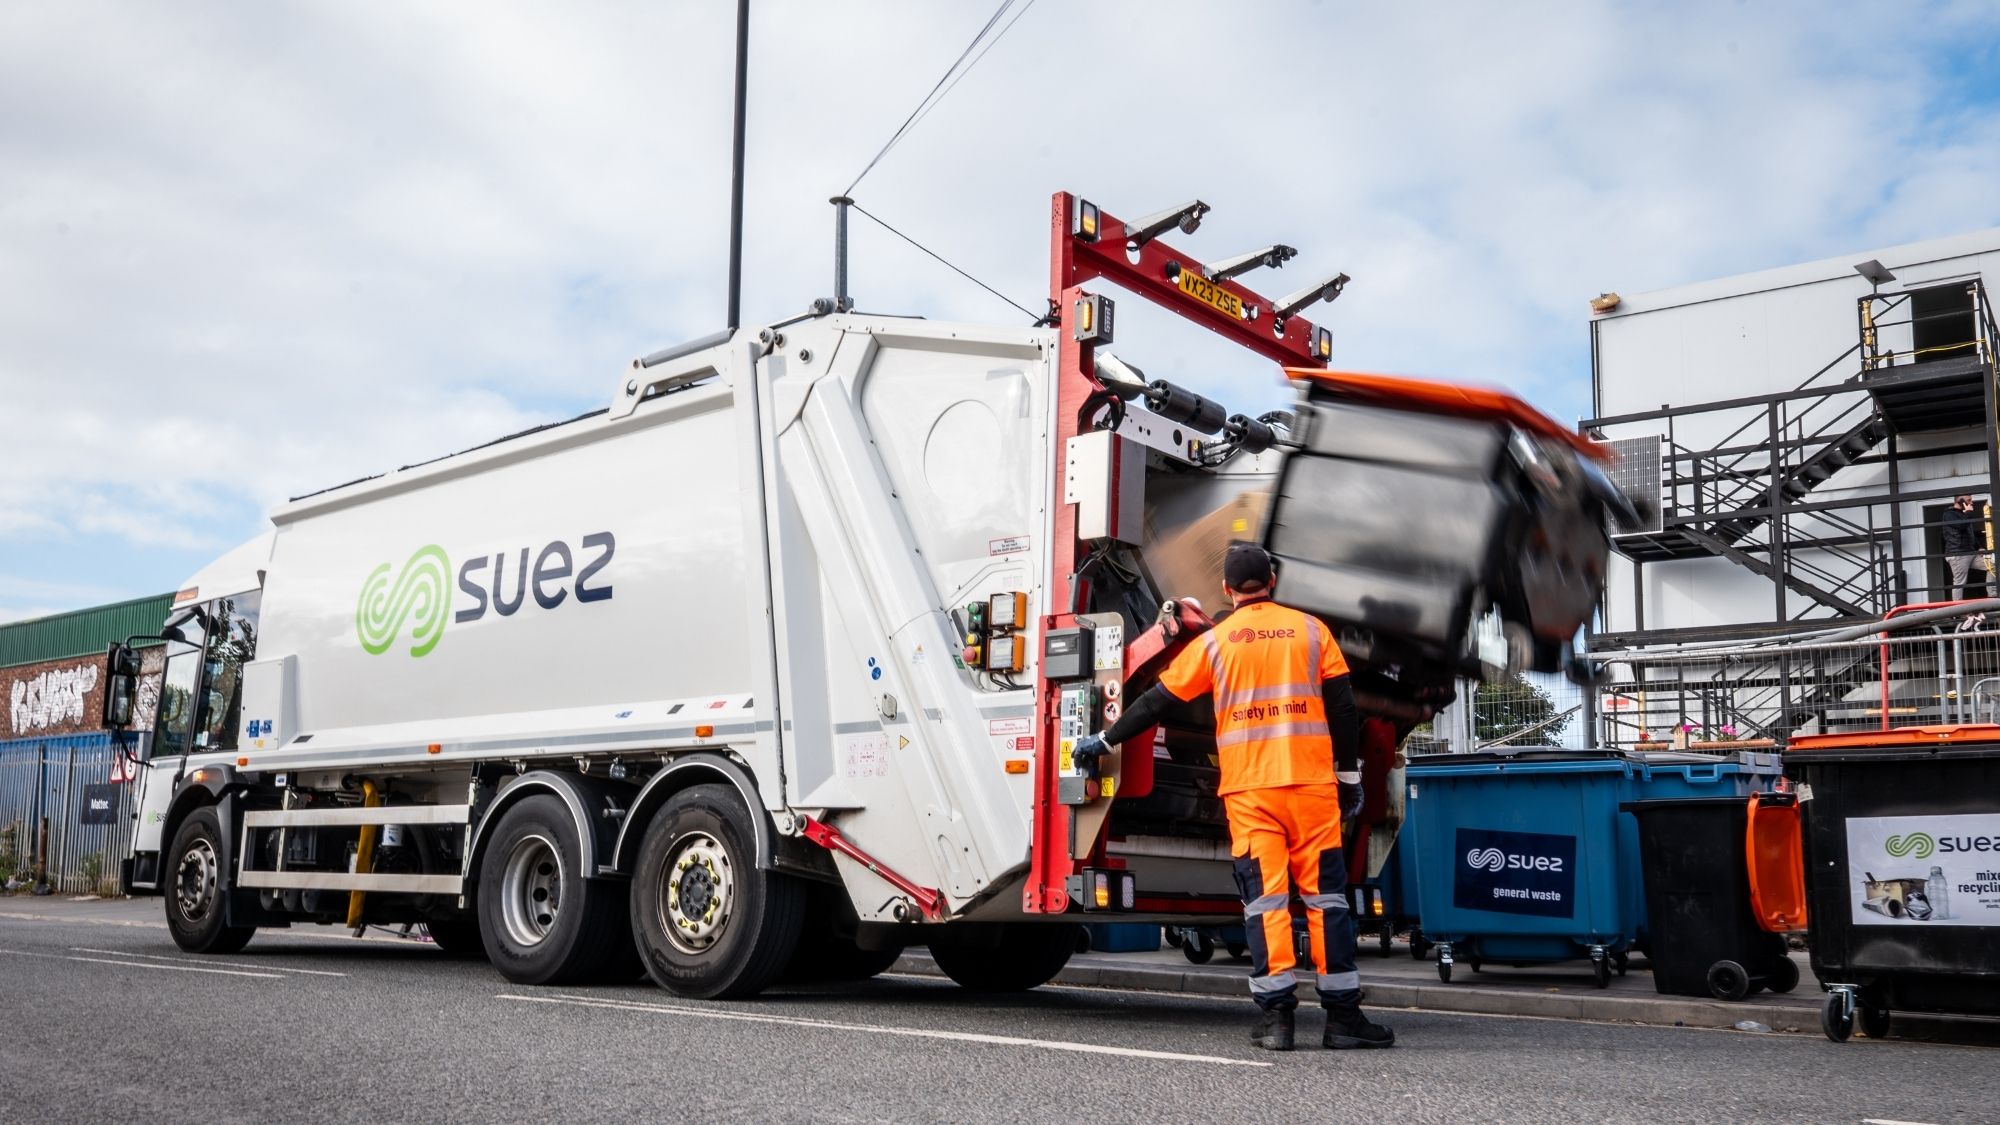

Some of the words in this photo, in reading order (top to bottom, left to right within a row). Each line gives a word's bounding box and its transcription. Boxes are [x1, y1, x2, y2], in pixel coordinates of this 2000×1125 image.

[1184, 272, 1214, 303] VX23
[1216, 289, 1238, 316] ZSE
[455, 531, 615, 624] suez
[1257, 628, 1296, 640] suez
[1232, 705, 1265, 721] safety
[1268, 703, 1280, 717] in
[1282, 700, 1308, 715] mind
[1507, 854, 1563, 872] suez
[1493, 887, 1530, 899] general
[1531, 890, 1561, 902] waste
[1958, 881, 2000, 895] recycli
